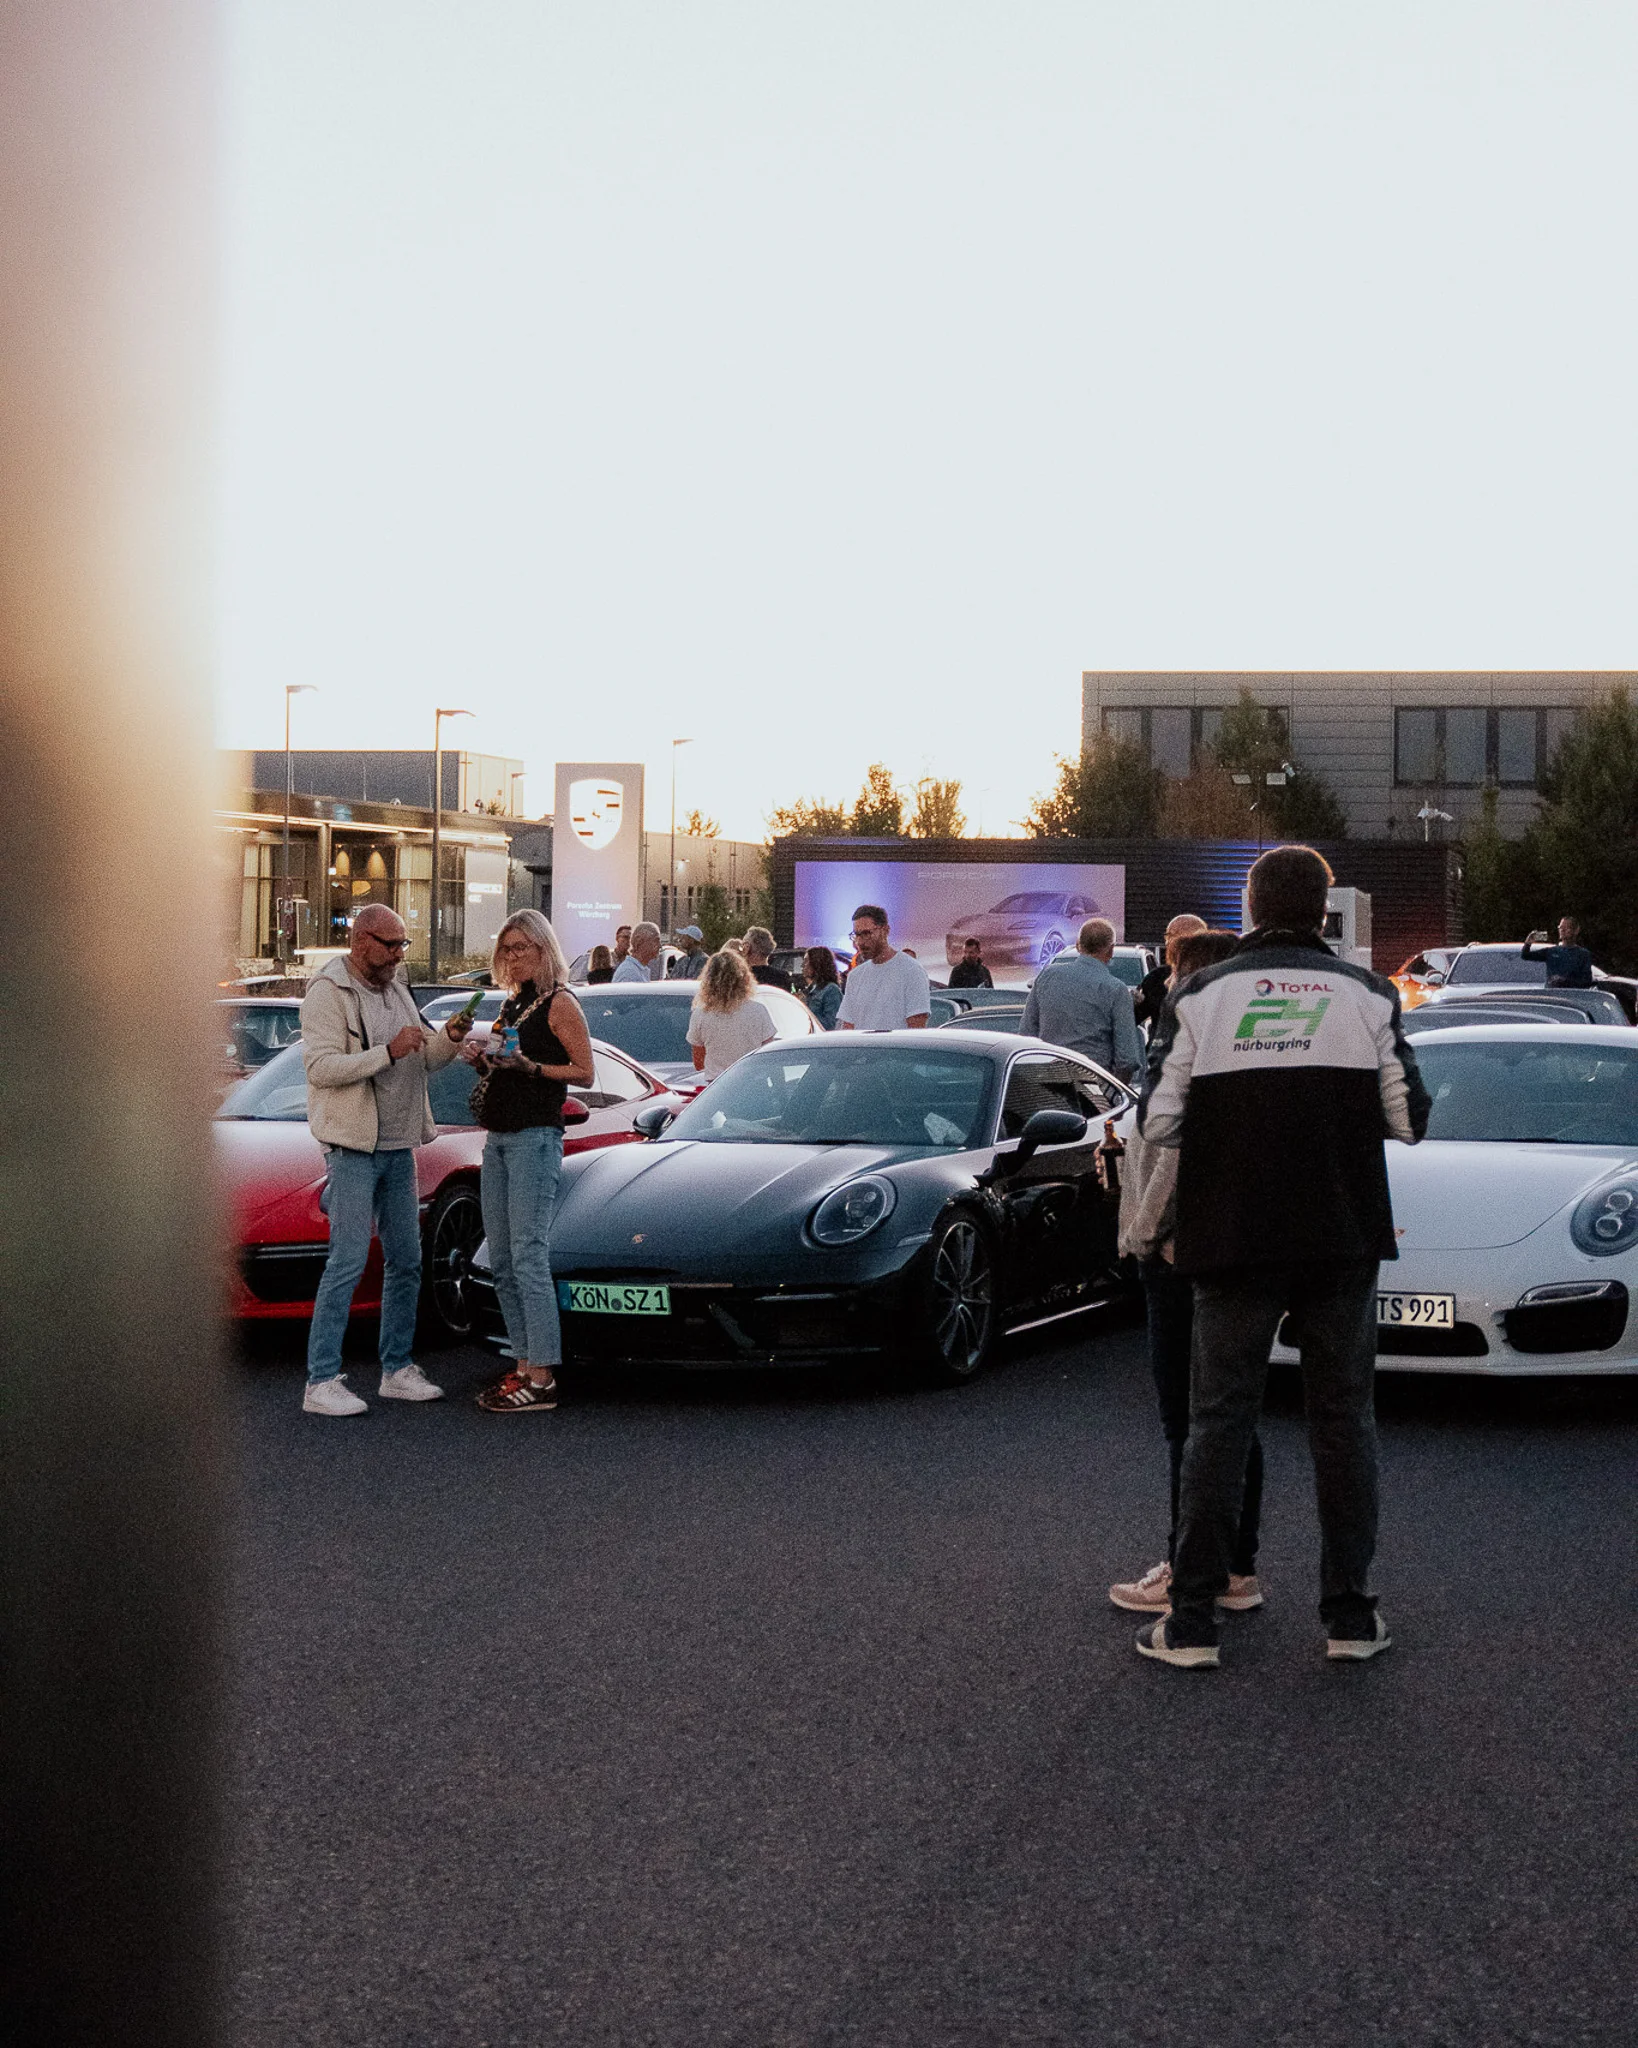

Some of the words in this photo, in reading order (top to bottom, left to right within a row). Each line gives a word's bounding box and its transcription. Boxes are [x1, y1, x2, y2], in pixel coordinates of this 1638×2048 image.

[1277, 982, 1334, 993] TOTAL
[1233, 1038, 1311, 1052] nürburgring
[570, 1287, 609, 1309] KÖN
[1409, 1298, 1449, 1323] 991
